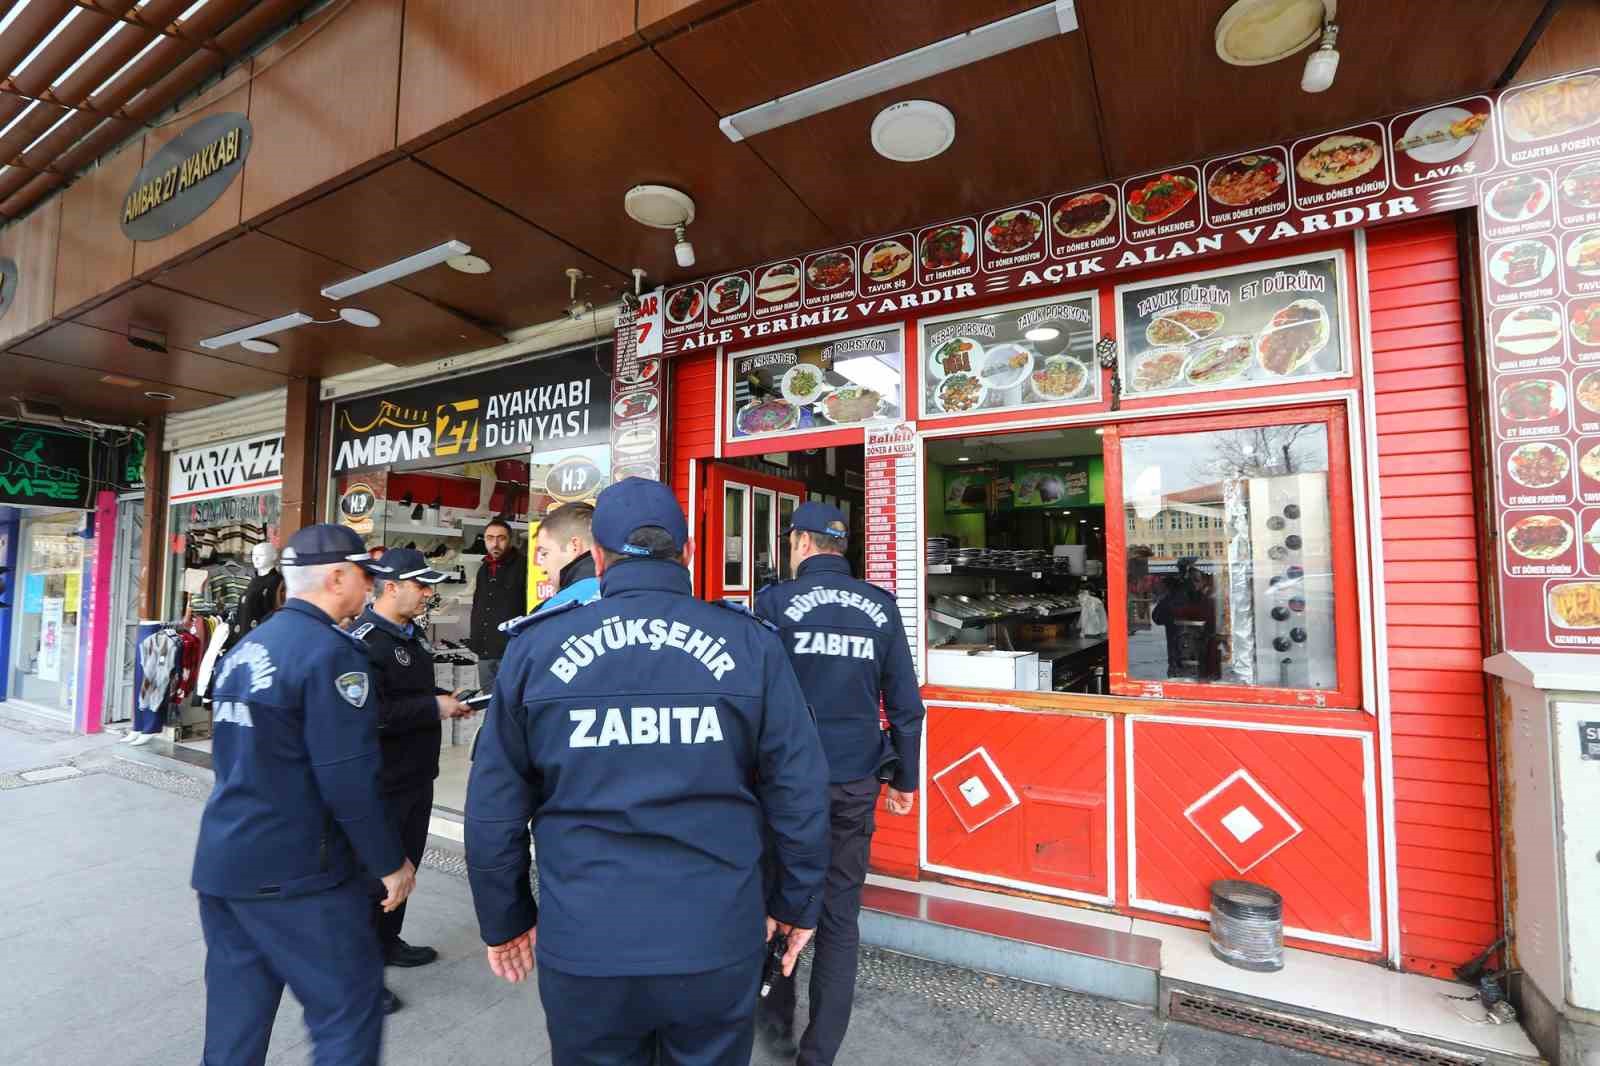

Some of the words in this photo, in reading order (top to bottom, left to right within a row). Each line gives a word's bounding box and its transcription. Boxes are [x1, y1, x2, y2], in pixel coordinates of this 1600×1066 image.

[124, 176, 162, 223] AMBAR
[163, 164, 179, 201] 27
[178, 127, 240, 191] AYAKKABI
[1413, 161, 1475, 183] LAVAŞ
[1298, 193, 1324, 207] TAVUK
[1325, 188, 1354, 201] DÖNER
[1355, 180, 1386, 195] DÜRÜM
[1131, 227, 1156, 239] TAVUK
[1157, 219, 1195, 236] İSKENDER
[1211, 215, 1231, 224] TAVUK
[1056, 246, 1065, 255] ET
[1066, 240, 1090, 253] DÖNER
[1091, 235, 1117, 249] DÜRÜM
[680, 328, 734, 352] AİLE
[740, 305, 849, 339] YERİMİZ
[856, 282, 978, 317] VARDIR
[1018, 257, 1106, 287] AÇIK
[1115, 234, 1223, 269] ALAN
[1235, 196, 1420, 245] VARDIR
[868, 282, 892, 294] TAVUK
[894, 278, 906, 290] ŞİŞ
[925, 272, 935, 282] ET
[936, 265, 971, 280] İSKENDER
[1240, 279, 1260, 303] ET
[1261, 269, 1325, 296] DÜRÜM
[1137, 288, 1179, 317] TAVUK
[1179, 284, 1231, 307] DÜRÜM
[486, 378, 591, 420] AYAKKABI
[335, 427, 431, 471] AMBAR
[486, 408, 589, 448] DÜNYASI
[784, 585, 889, 629] BÜYÜKŞEHİR
[549, 615, 736, 685] BÜYÜKŞEHİR
[793, 632, 875, 661] ZABITA
[569, 706, 724, 749] ZABITA
